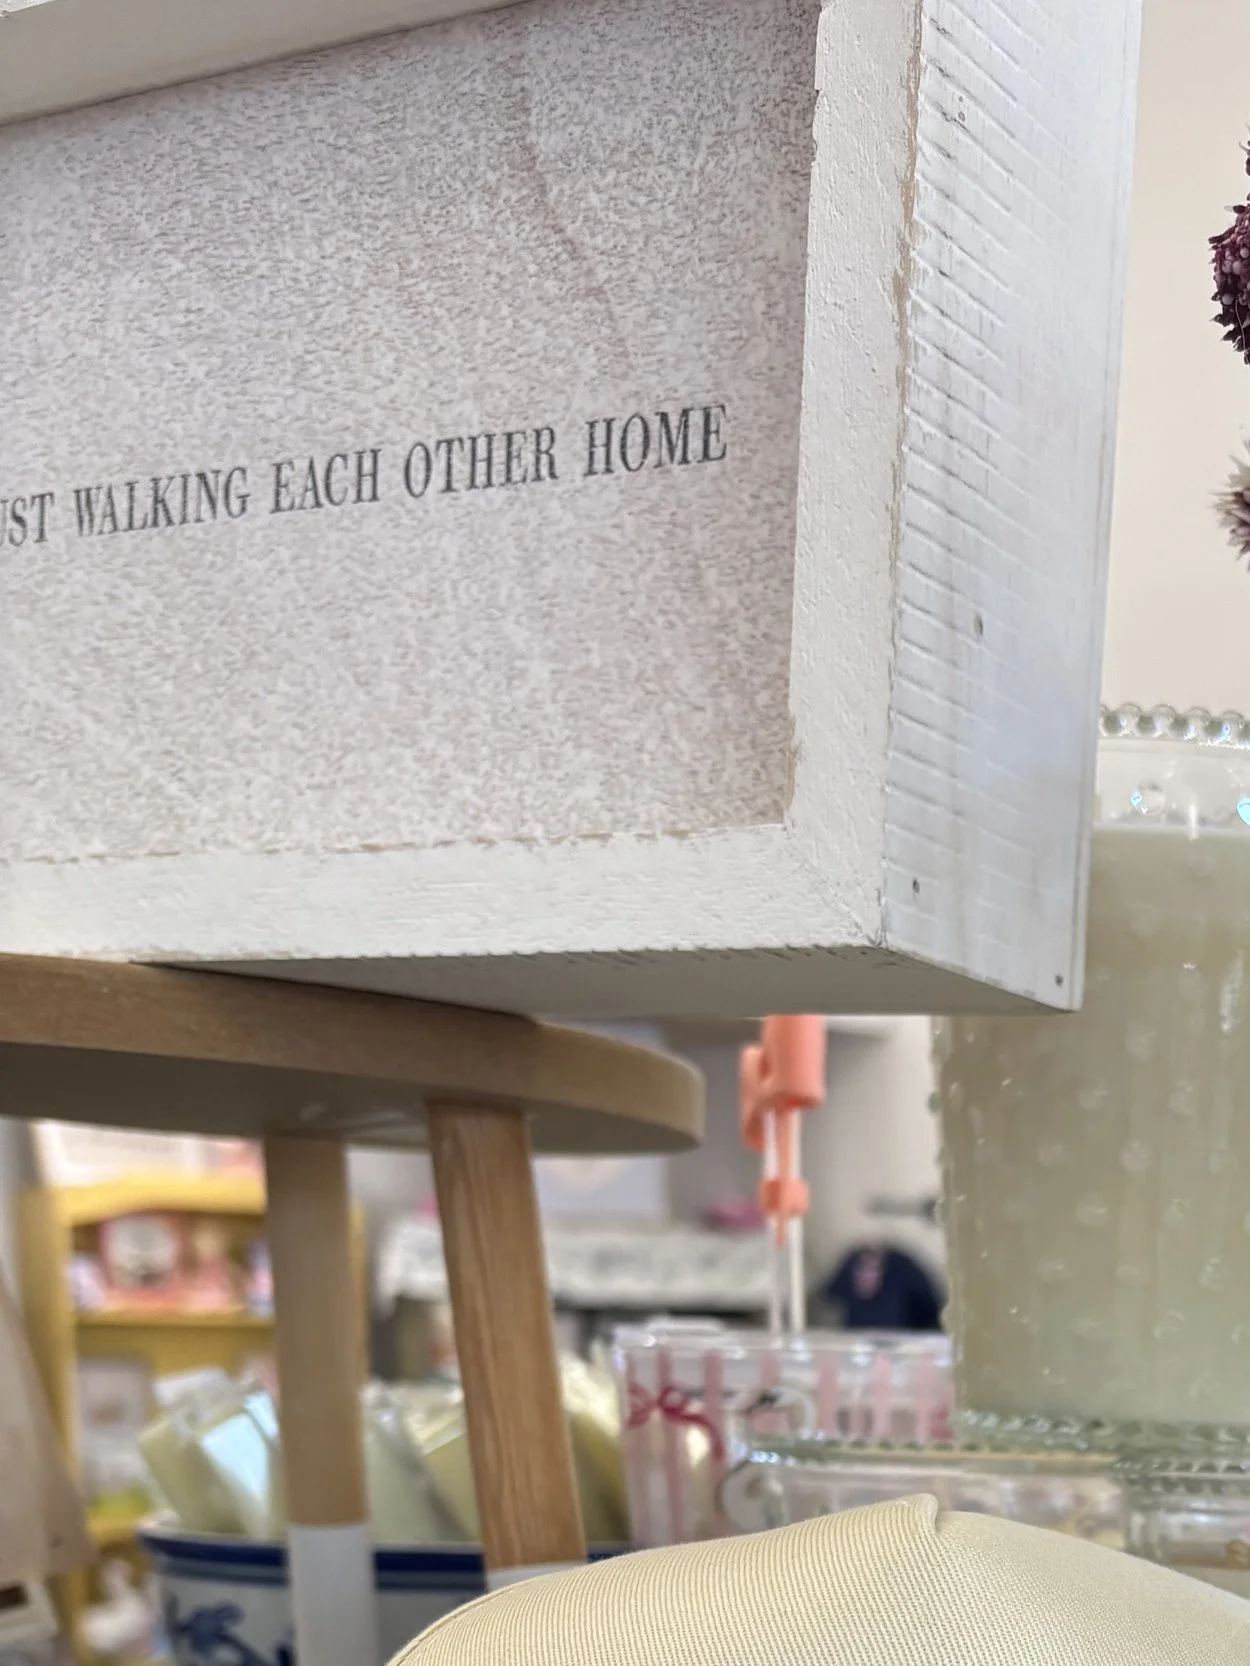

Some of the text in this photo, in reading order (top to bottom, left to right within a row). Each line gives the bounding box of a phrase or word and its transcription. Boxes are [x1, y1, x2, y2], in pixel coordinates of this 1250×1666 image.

[73, 466, 251, 537] WALKING
[270, 448, 383, 513] EACH
[403, 426, 559, 498] OTHER
[583, 404, 728, 477] HOME
